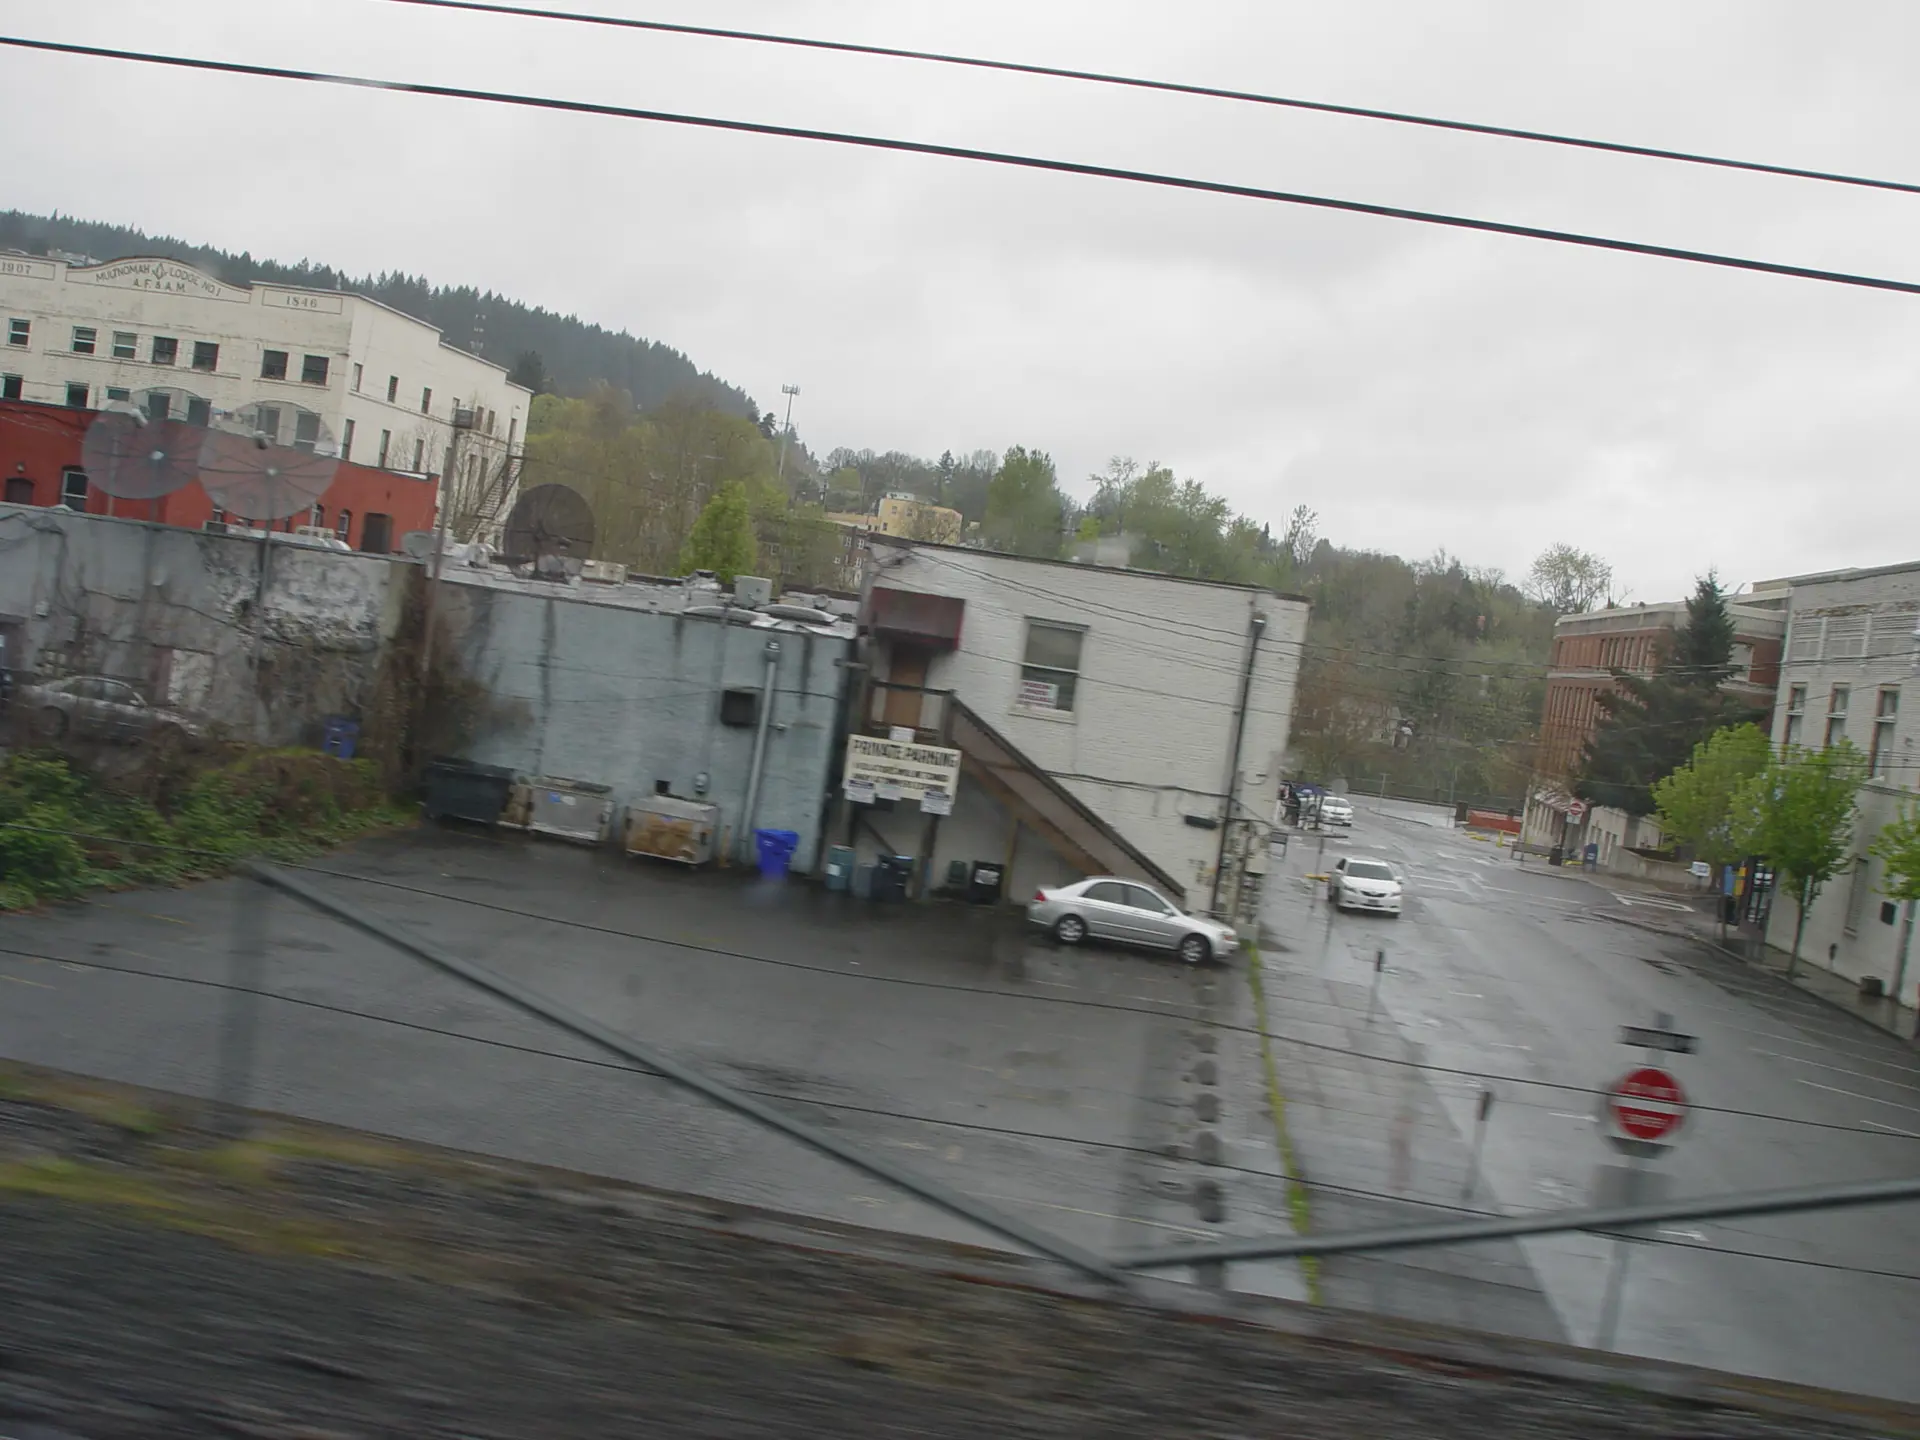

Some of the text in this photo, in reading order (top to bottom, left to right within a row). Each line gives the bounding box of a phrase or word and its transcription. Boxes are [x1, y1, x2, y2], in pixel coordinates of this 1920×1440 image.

[2, 260, 32, 275] 1907
[95, 263, 150, 282] MULTNOMAH
[169, 267, 199, 286] LODGE
[286, 295, 318, 308] 1846
